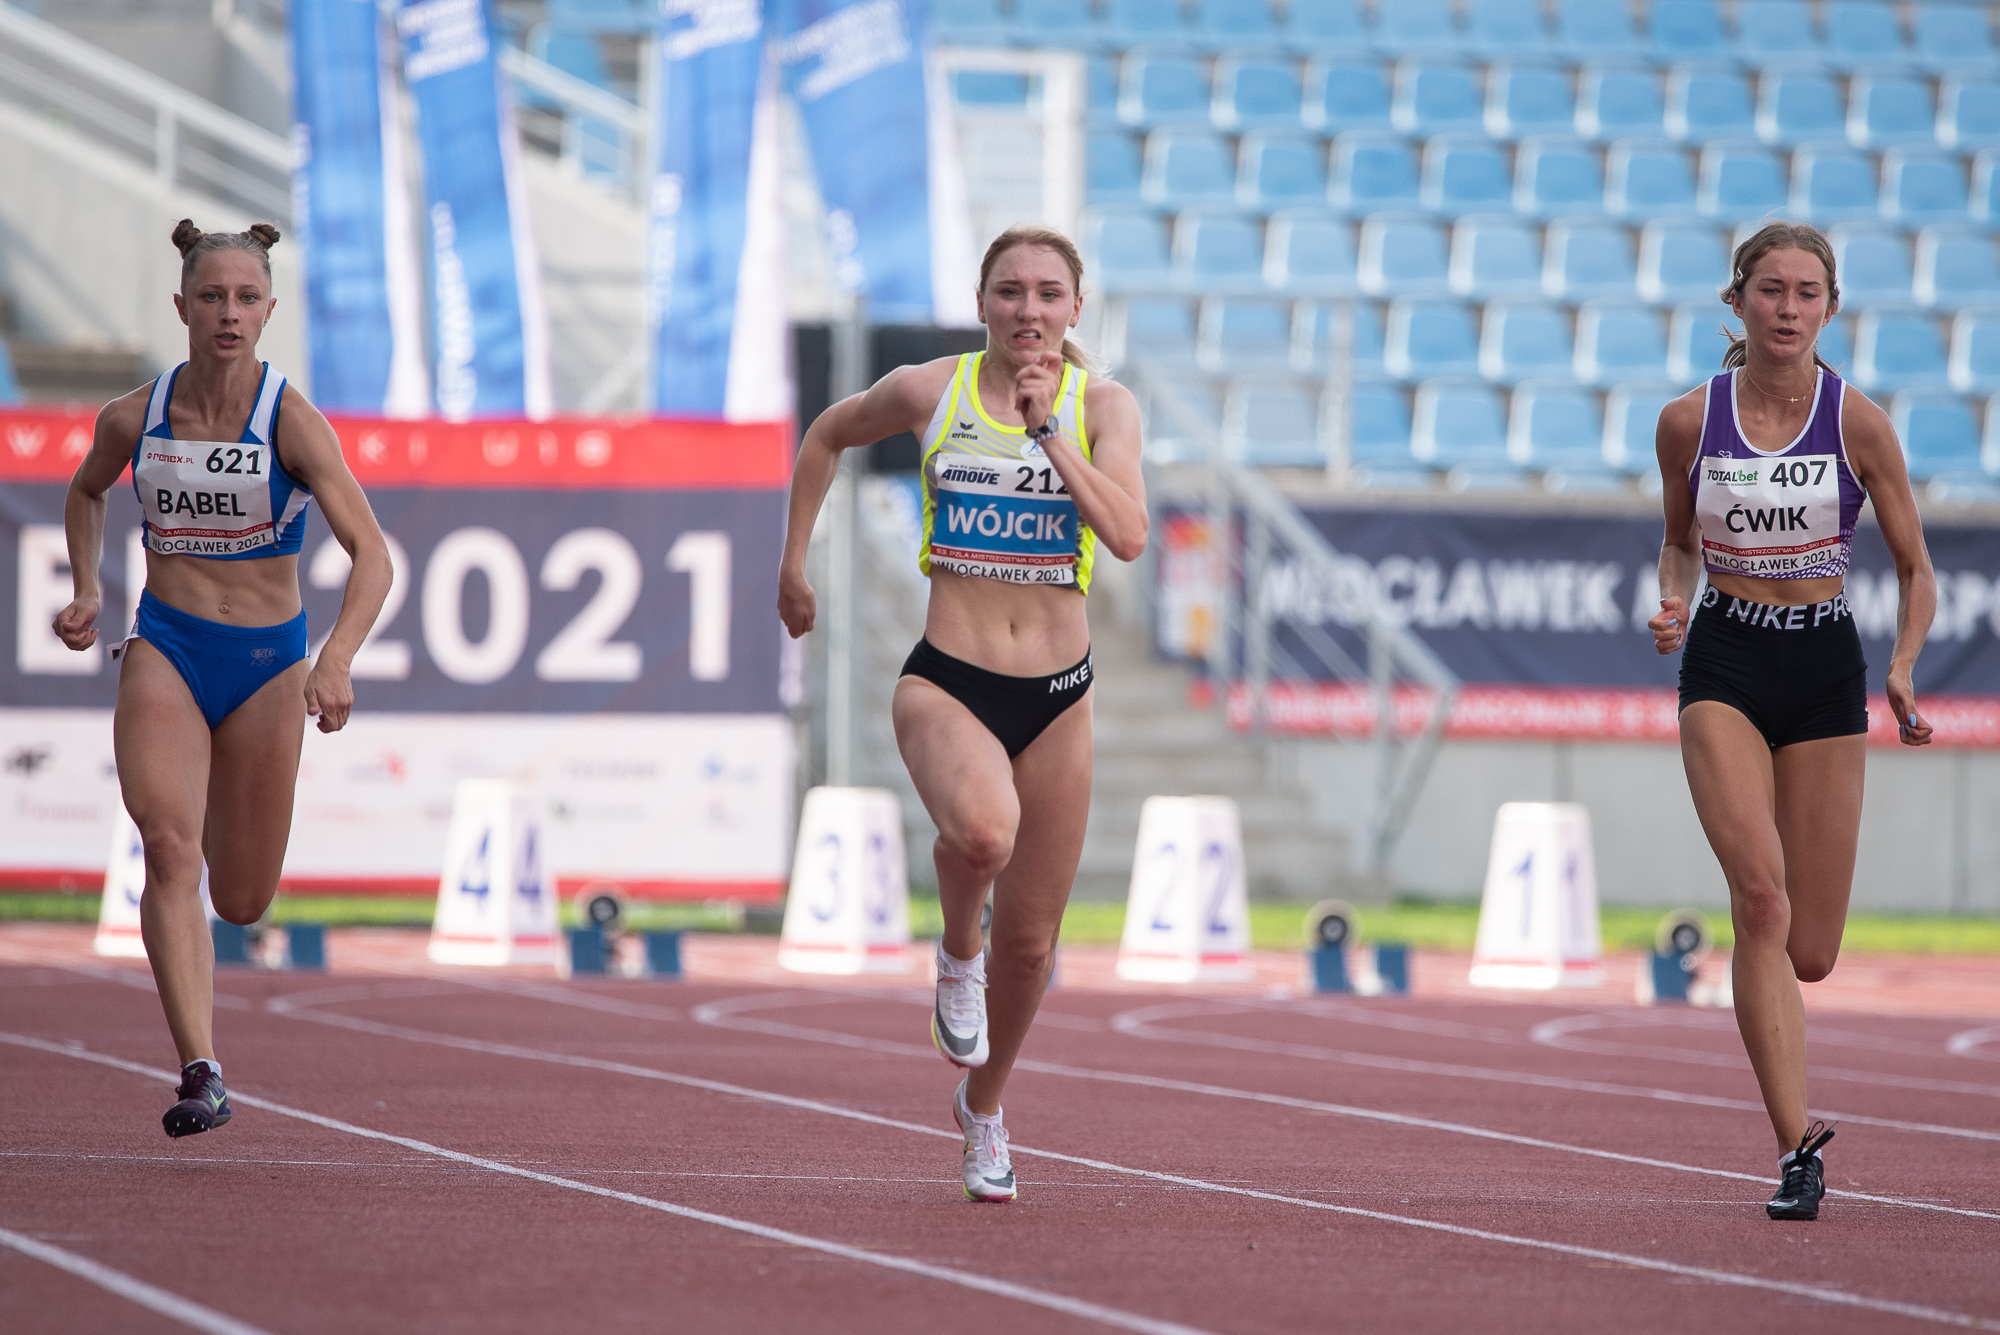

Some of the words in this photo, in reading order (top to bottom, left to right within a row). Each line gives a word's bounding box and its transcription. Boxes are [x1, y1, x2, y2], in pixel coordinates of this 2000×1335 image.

[952, 432, 978, 440] erima
[205, 447, 261, 475] 621
[941, 468, 1000, 485] 4MOVE
[1769, 460, 1828, 487] 407
[156, 488, 247, 520] BĄBEL
[1725, 503, 1809, 534] ĆWIK
[947, 503, 1067, 541] WÓJCIK
[236, 533, 266, 552] 2021
[949, 551, 970, 559] PZLA
[970, 553, 1027, 564] MISTRZOSTWA
[1738, 547, 1794, 555] MISTRZOSTWA
[1794, 542, 1820, 553] POLSKI
[1820, 538, 1834, 546] U18
[936, 559, 1031, 582] WŁOCŁAWEK
[1034, 568, 1066, 583] 2021
[1711, 553, 1799, 572] WŁOCŁAWEK
[1802, 549, 1832, 567] 2021
[1725, 597, 1808, 630] NIKE
[1049, 663, 1089, 694] NIKE
[459, 825, 493, 914] 4
[517, 823, 542, 917] 4
[809, 830, 845, 924] 3
[1148, 841, 1180, 932] 2
[1203, 841, 1234, 936] 2
[1510, 850, 1535, 939] 1
